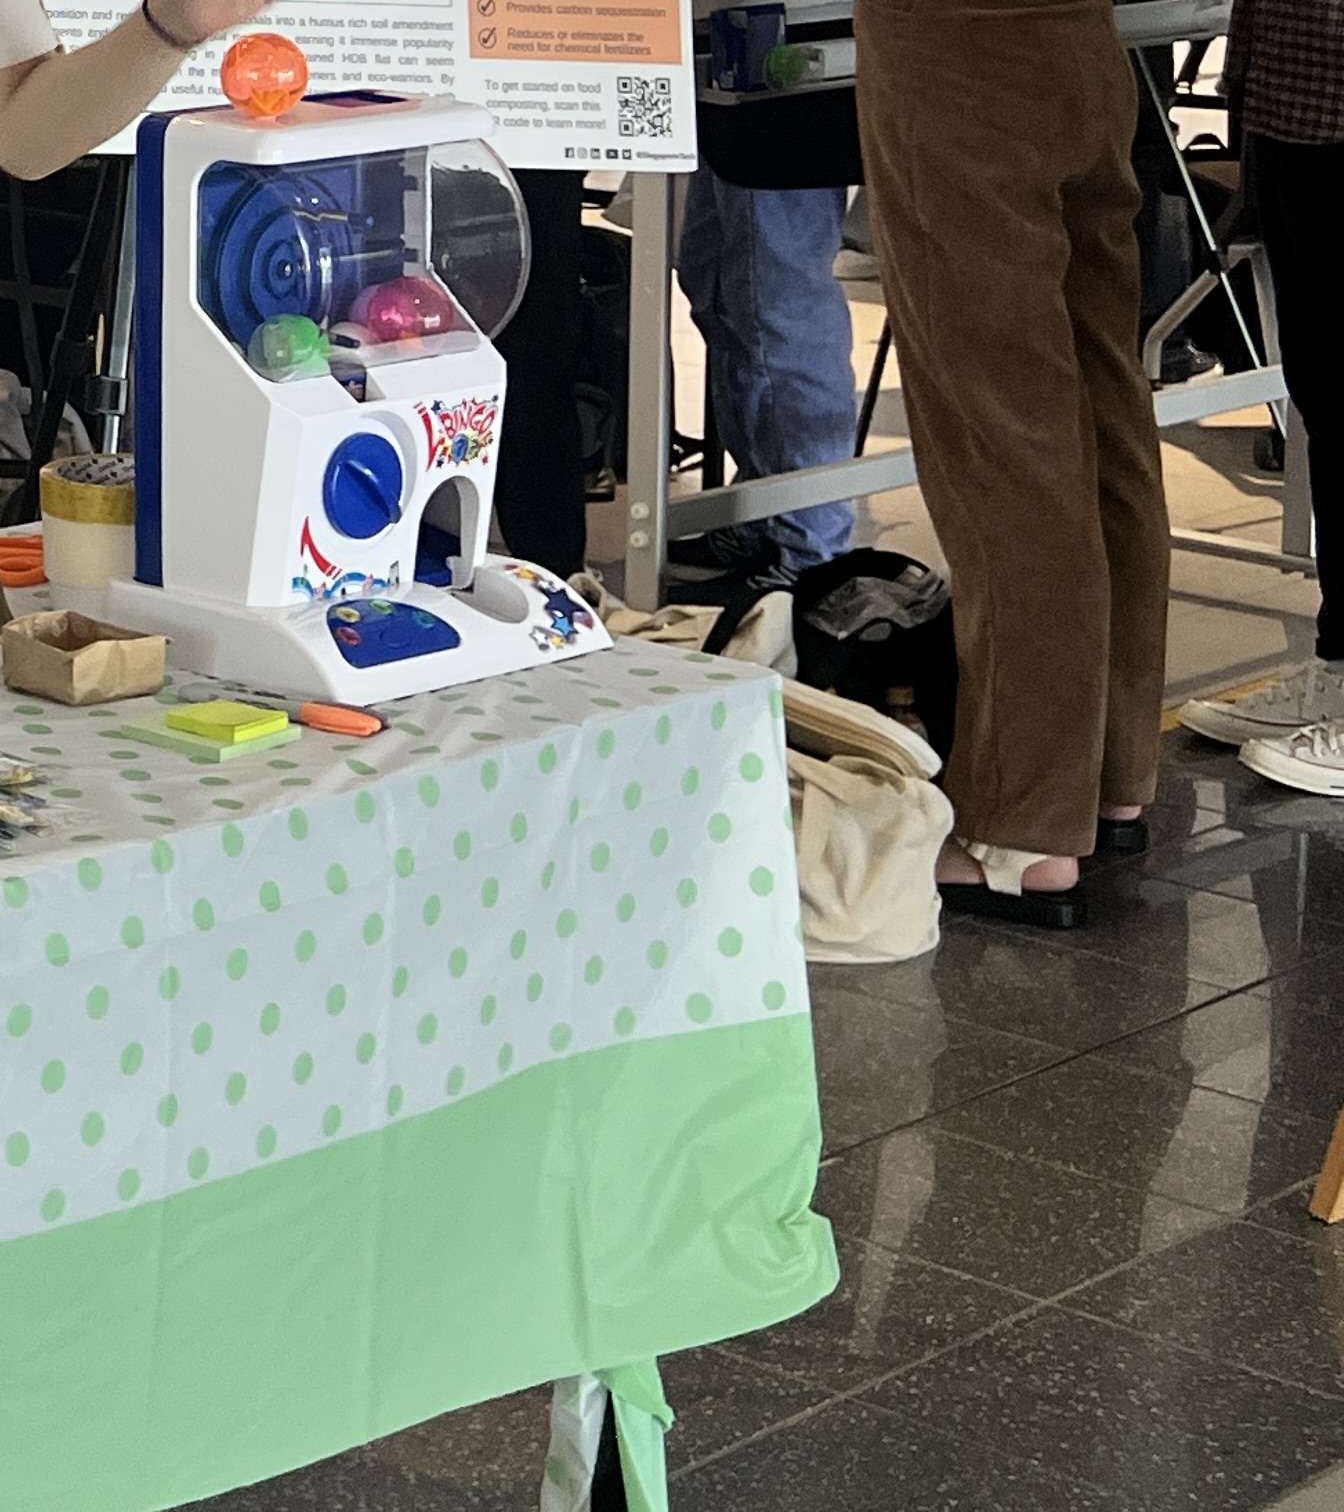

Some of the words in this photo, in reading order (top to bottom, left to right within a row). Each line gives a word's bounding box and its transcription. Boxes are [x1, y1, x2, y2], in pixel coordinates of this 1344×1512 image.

[485, 79, 499, 90] To
[502, 81, 519, 93] get
[522, 81, 558, 92] started
[561, 84, 575, 92] on
[578, 82, 601, 93] food
[486, 99, 551, 112] composting,
[554, 102, 579, 111] scan
[582, 101, 601, 111] this
[439, 405, 496, 439] BINGO
